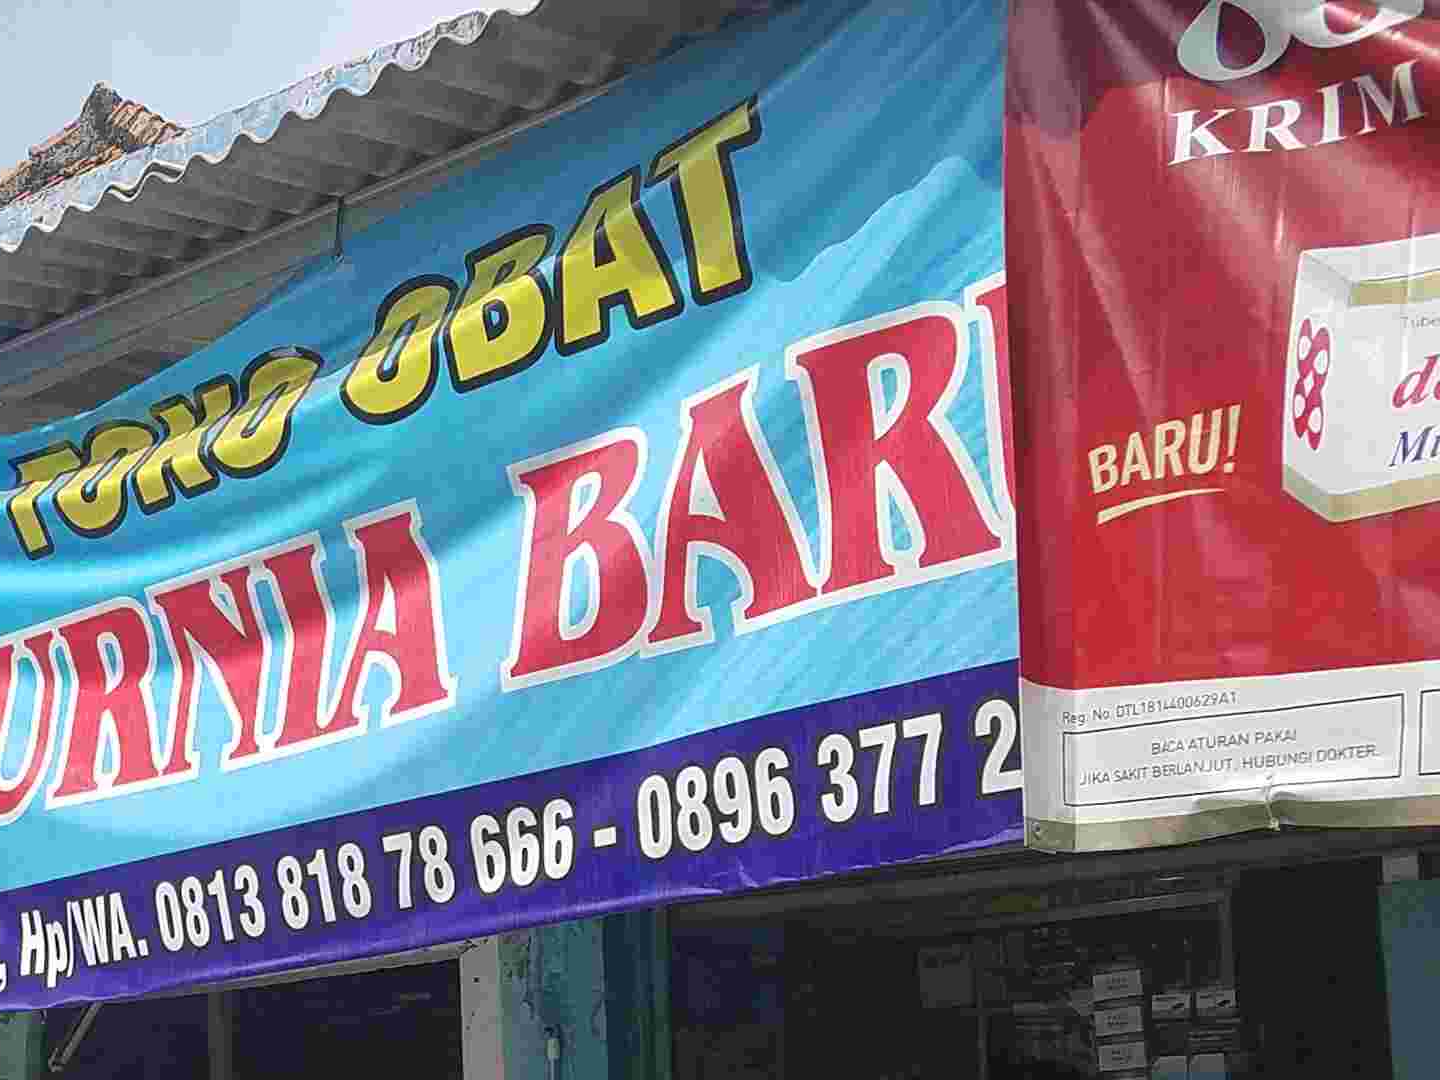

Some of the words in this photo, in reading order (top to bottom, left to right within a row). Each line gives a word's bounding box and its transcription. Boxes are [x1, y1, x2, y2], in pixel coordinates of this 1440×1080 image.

[1167, 60, 1425, 166] KRIM
[340, 97, 762, 425] OBAT
[1087, 404, 1241, 494] BARU!
[1079, 771, 1111, 786] JIKA
[1113, 766, 1148, 782] SAKIT
[1242, 752, 1312, 769] HUBUNGI
[1151, 740, 1185, 755] BACA
[1188, 733, 1249, 750] ATURAN
[1255, 728, 1297, 745] PAKAI
[20, 892, 149, 988] Hp/WA.
[155, 864, 266, 952] 0813
[276, 842, 372, 930] 818
[382, 825, 456, 910] 78
[470, 798, 575, 894] 666
[593, 826, 618, 848] -
[636, 747, 795, 859] 0896
[817, 712, 943, 822] 377
[974, 699, 1024, 794] 2
